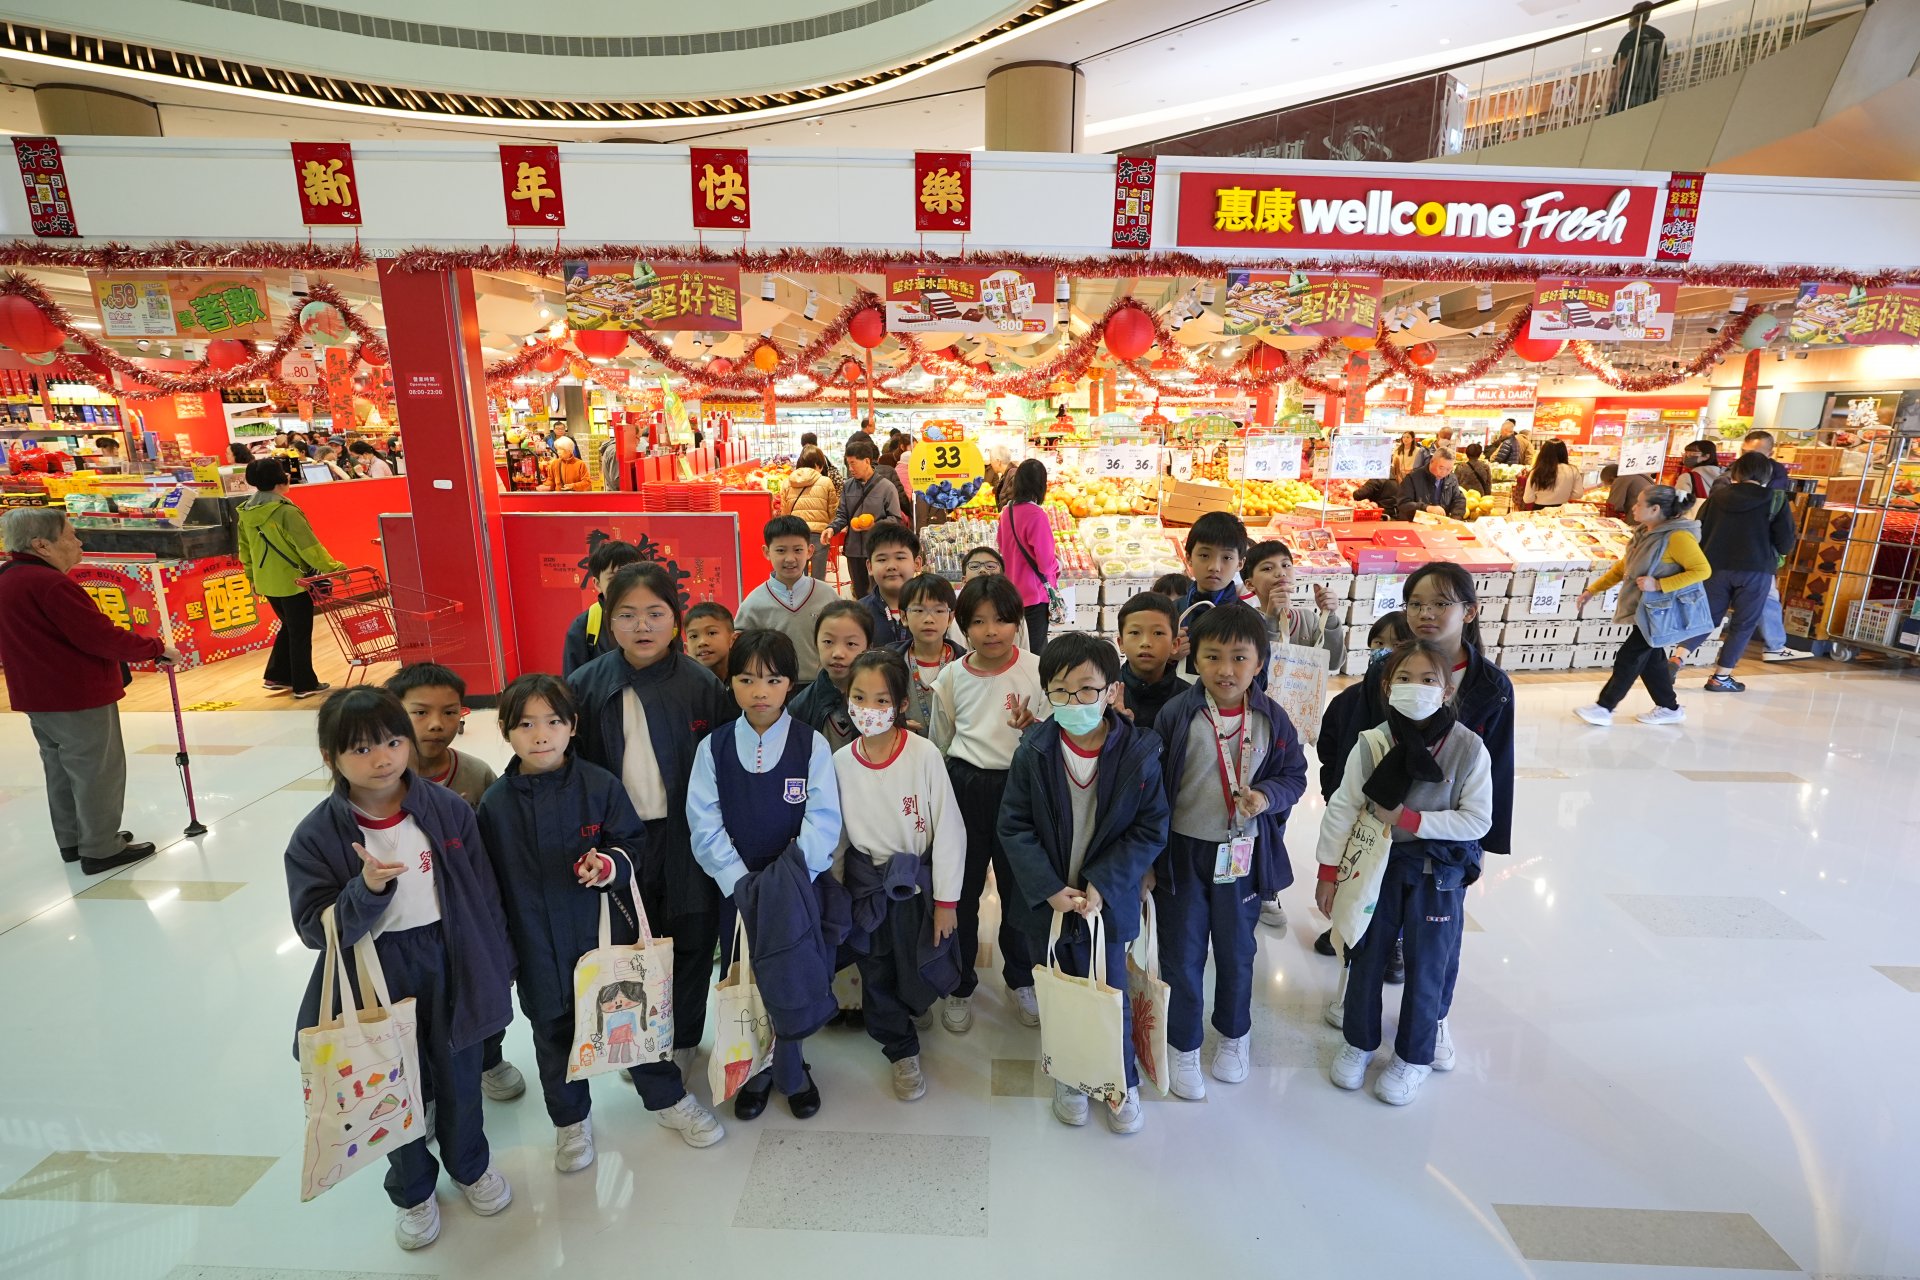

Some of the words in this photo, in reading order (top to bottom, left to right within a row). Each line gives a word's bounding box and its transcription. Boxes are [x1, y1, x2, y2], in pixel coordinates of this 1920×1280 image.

[301, 158, 352, 207] 新
[511, 161, 556, 212] 年
[699, 163, 747, 211] 快
[920, 168, 965, 214] 樂
[1214, 186, 1296, 234] 惠康
[1297, 189, 1515, 238] wellcome
[1518, 188, 1631, 249] Fresh
[651, 283, 737, 322] 堅好運
[1301, 291, 1377, 329] 堅好運
[294, 366, 308, 378] 80
[1477, 390, 1497, 399] MILK
[1498, 390, 1505, 399] &
[1507, 390, 1533, 399] DAIRY
[934, 445, 961, 468] 33
[203, 563, 220, 574] HOT
